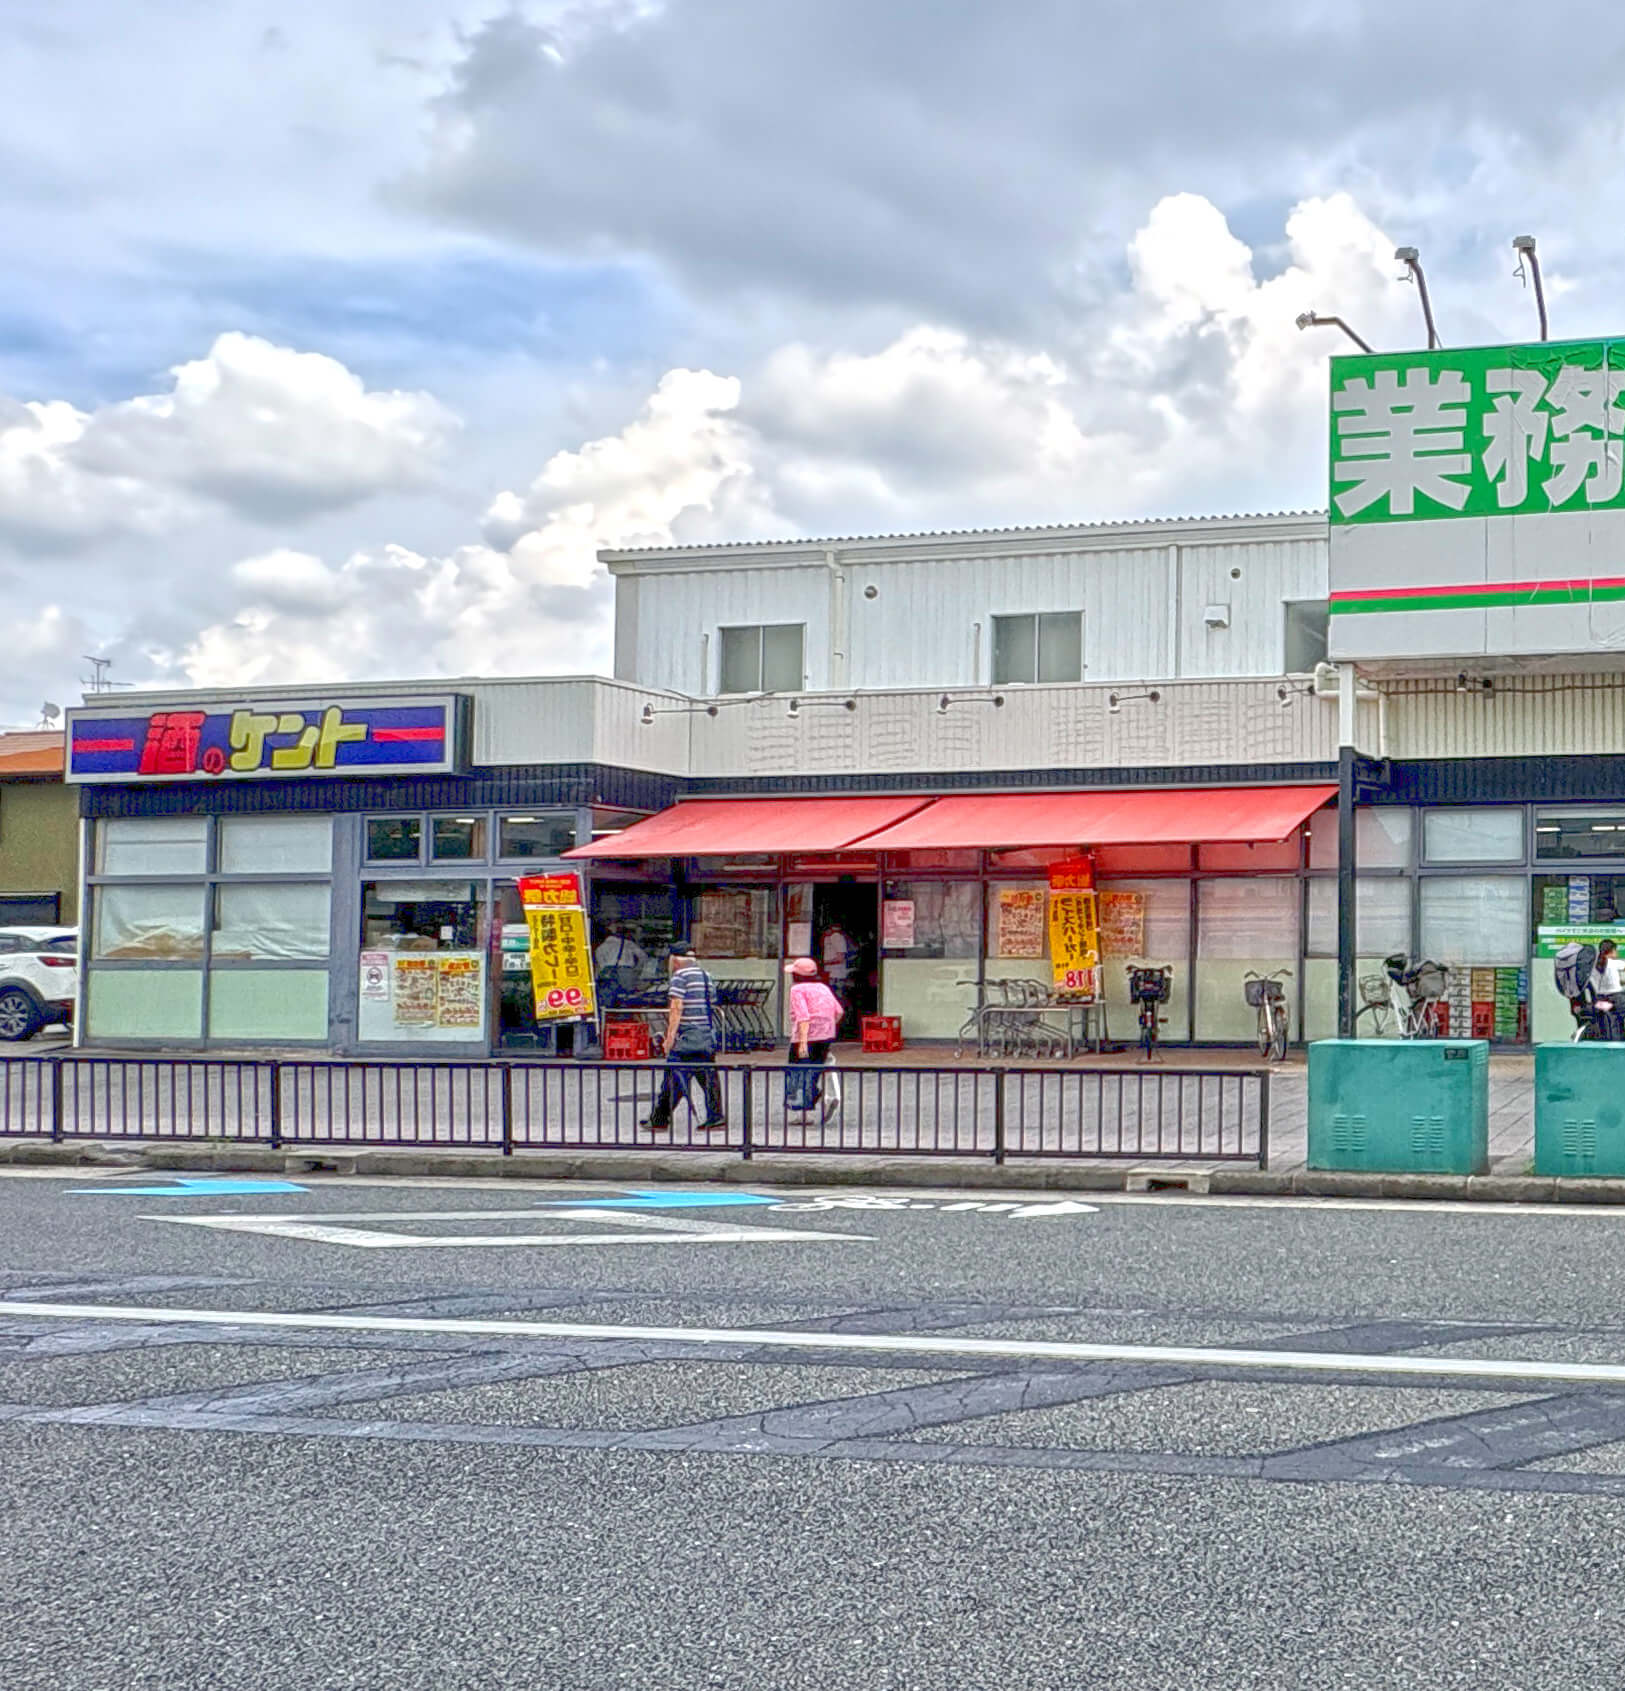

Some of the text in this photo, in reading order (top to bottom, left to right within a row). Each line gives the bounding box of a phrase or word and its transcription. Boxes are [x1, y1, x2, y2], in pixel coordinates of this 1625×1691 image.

[137, 705, 370, 776] 酒のケント
